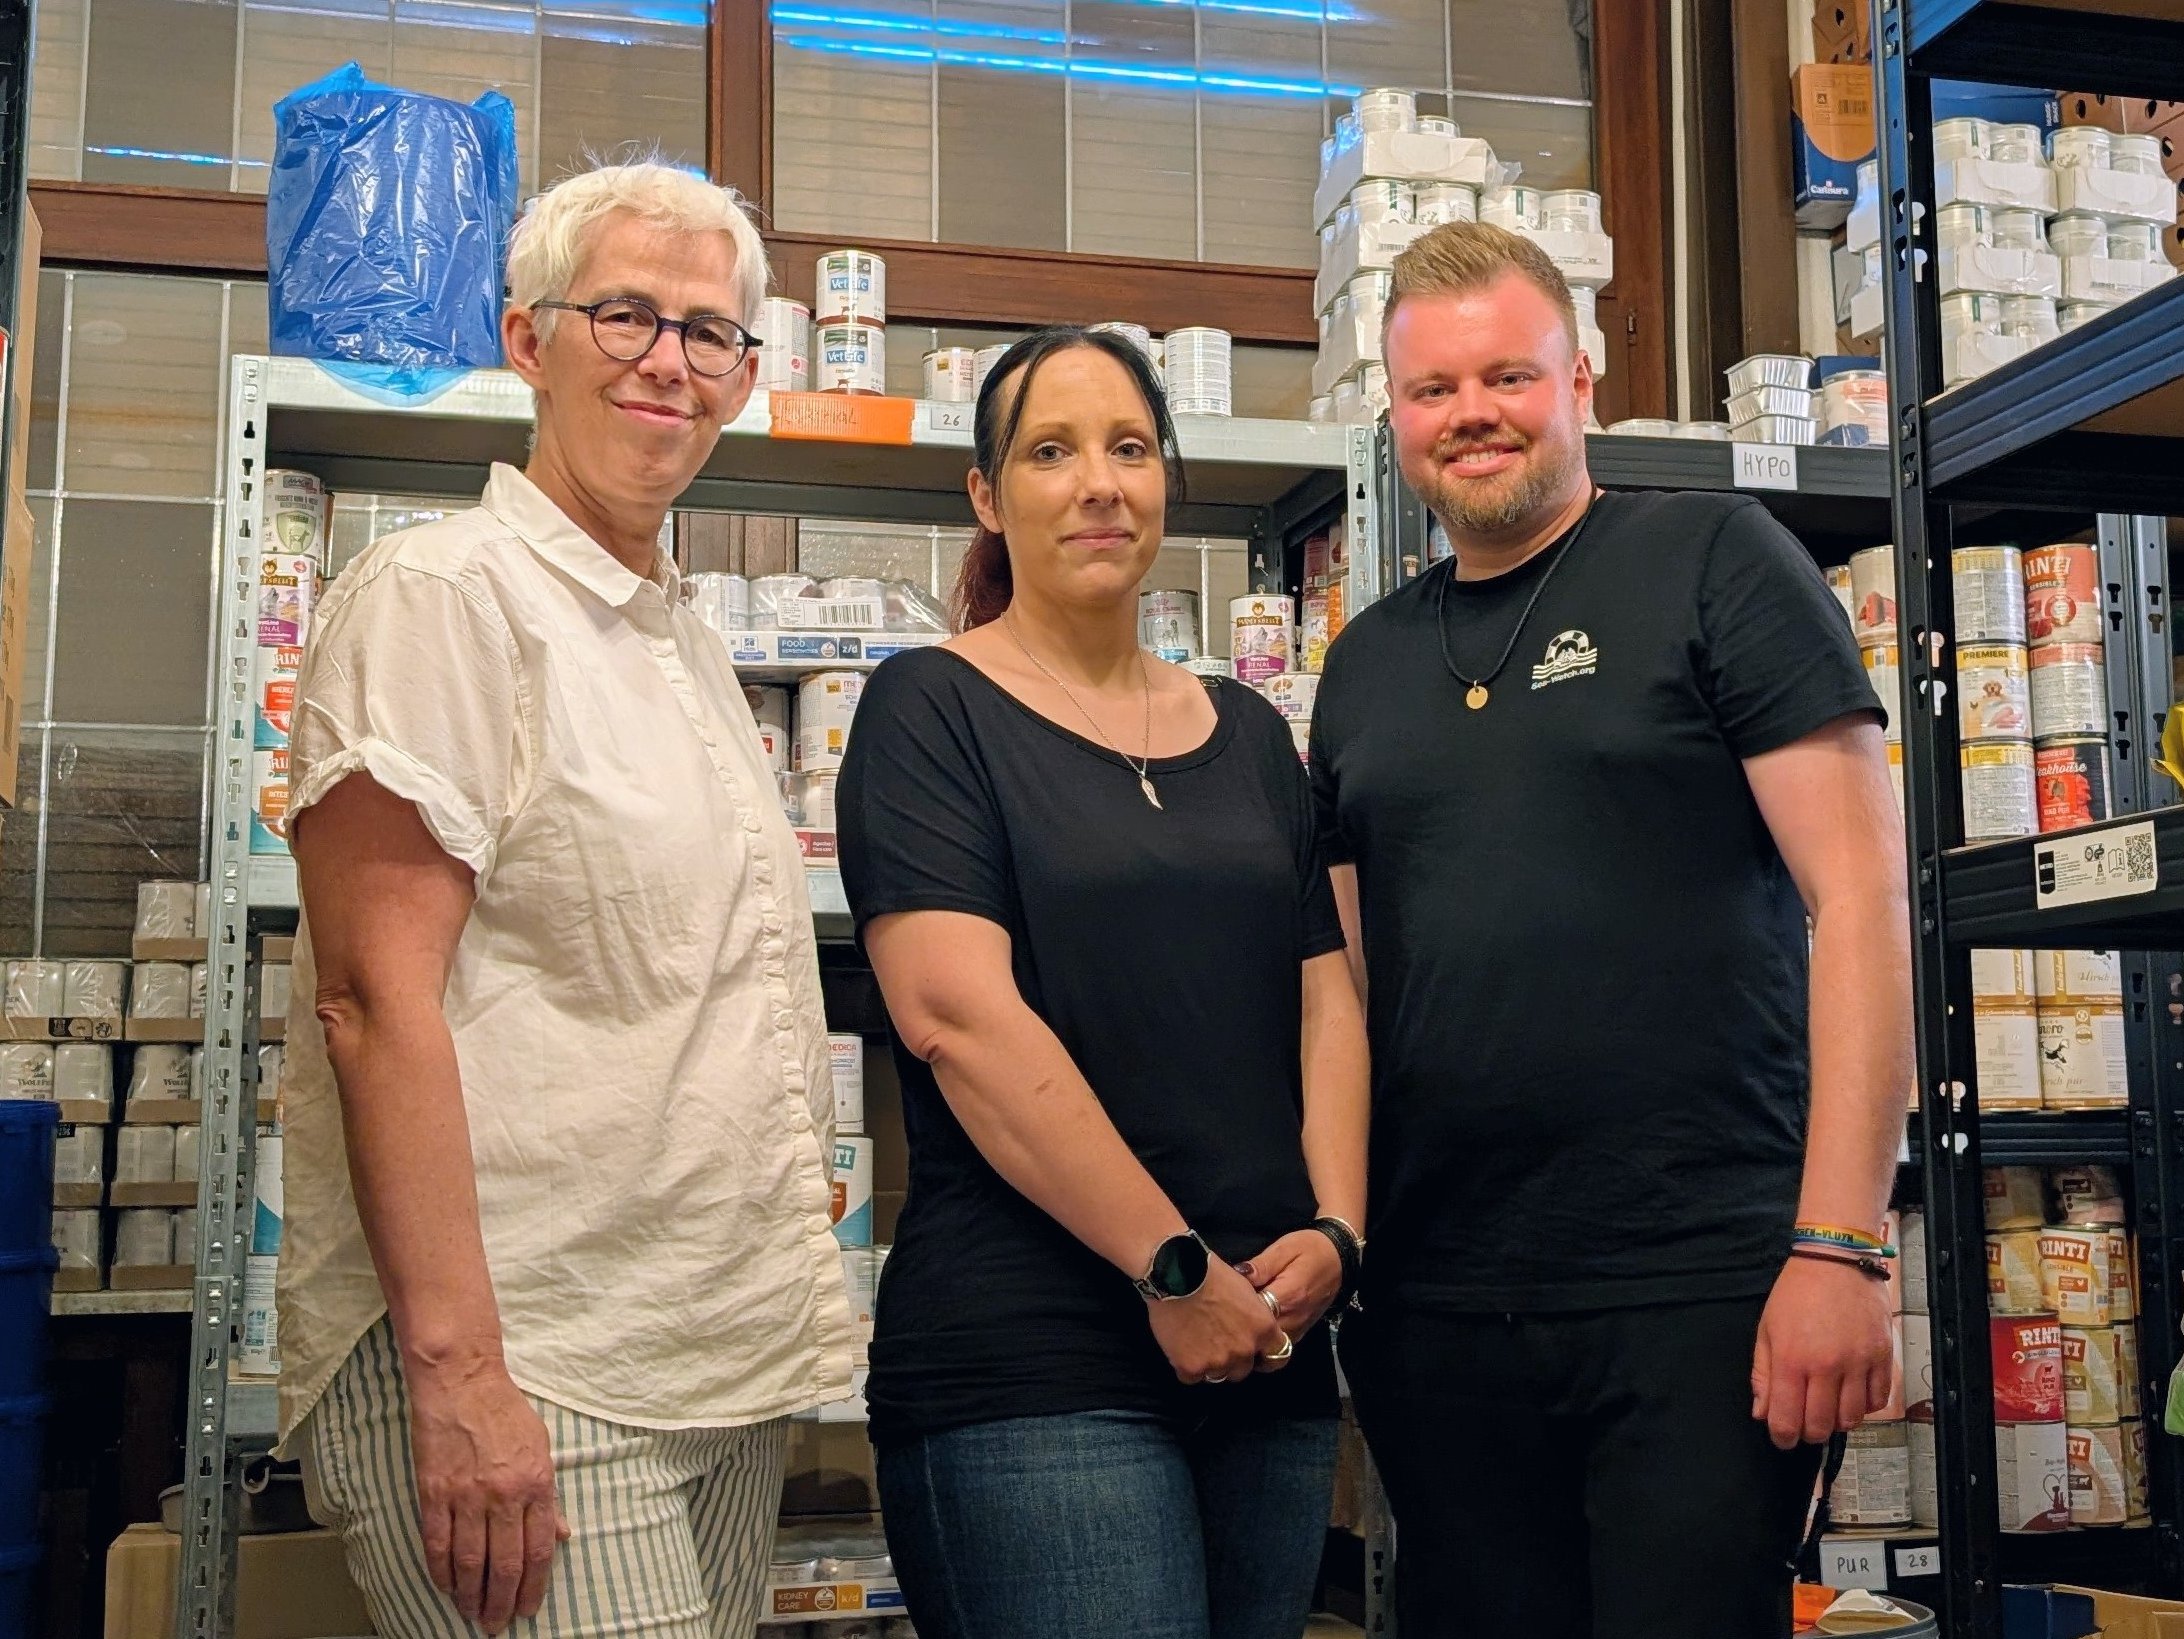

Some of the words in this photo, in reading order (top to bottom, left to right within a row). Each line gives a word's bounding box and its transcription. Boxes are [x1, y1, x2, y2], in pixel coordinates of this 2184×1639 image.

[943, 413, 960, 427] 26
[1744, 451, 1790, 478] HYPO
[781, 640, 806, 648] FOOD
[842, 645, 858, 654] z/d
[1963, 650, 2009, 660] PREMIERE
[2042, 1240, 2087, 1260] RINTI
[2020, 1326, 2060, 1347] RINT
[1837, 1556, 1870, 1573] PUR
[1908, 1554, 1928, 1568] 28
[777, 1592, 809, 1601] KIDNEY
[841, 1594, 860, 1604] k/d
[777, 1601, 801, 1611] CARE
